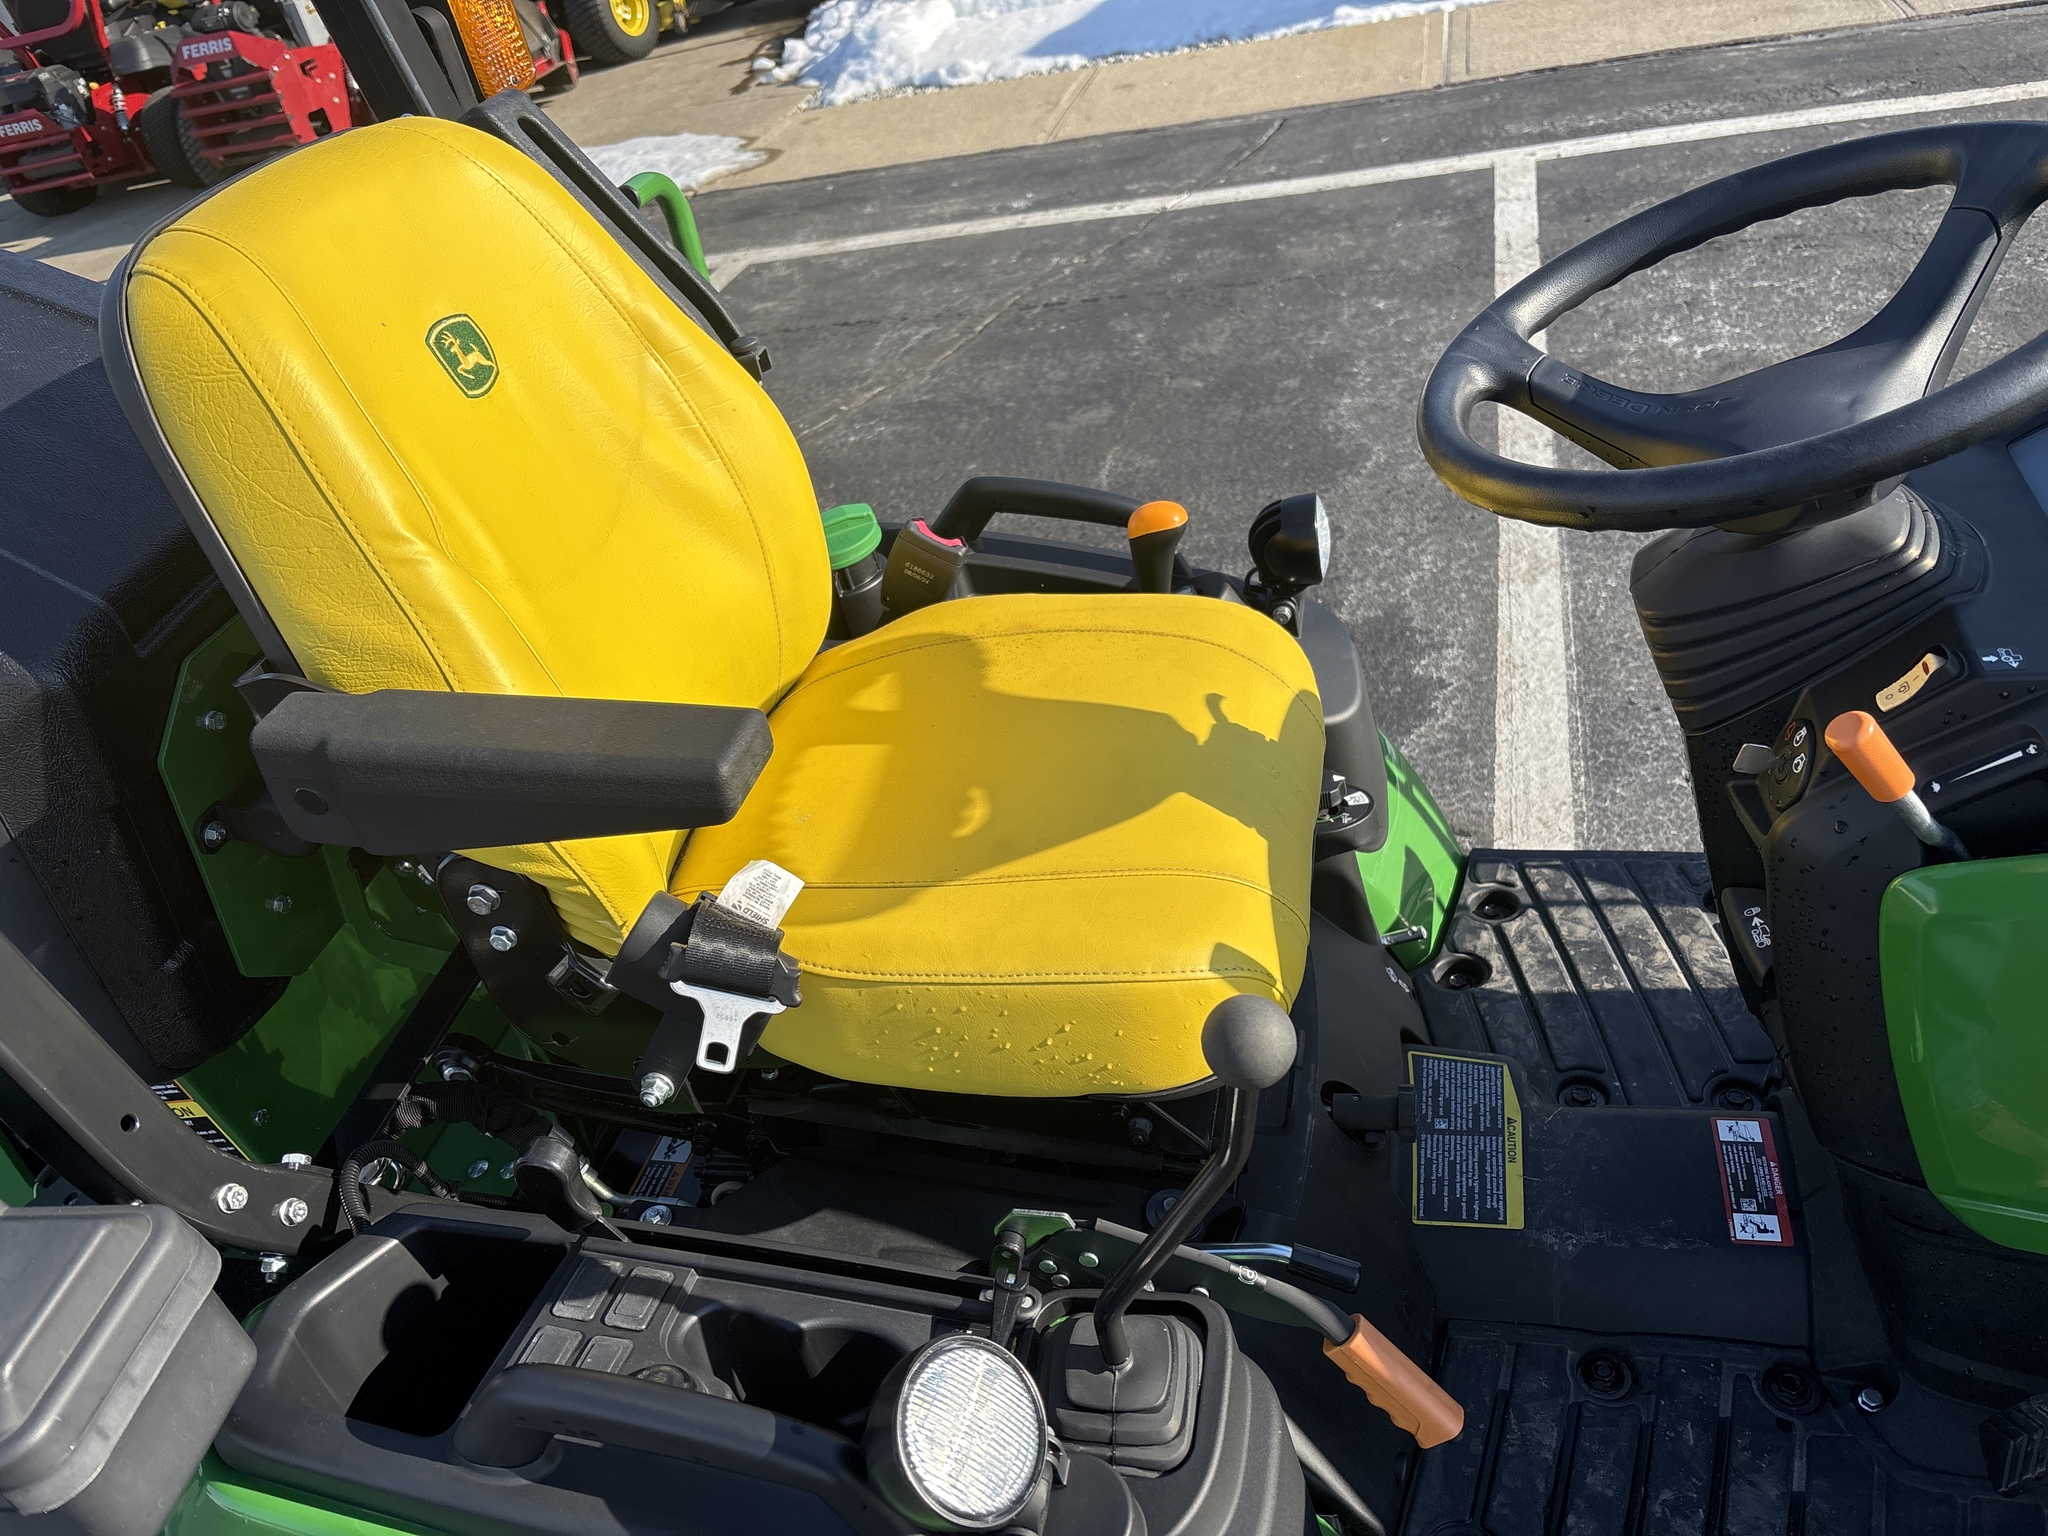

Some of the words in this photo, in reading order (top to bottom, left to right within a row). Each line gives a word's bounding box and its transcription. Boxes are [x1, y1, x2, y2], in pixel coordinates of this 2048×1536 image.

[182, 38, 233, 60] FERRIS
[0, 118, 43, 138] FERRIS
[1561, 373, 1651, 415] DEERE
[904, 562, 935, 580] 6186632
[742, 907, 770, 925] SHIELD
[1507, 1125, 1517, 1164] CAUTION
[1770, 1167, 1782, 1194] DANGER
